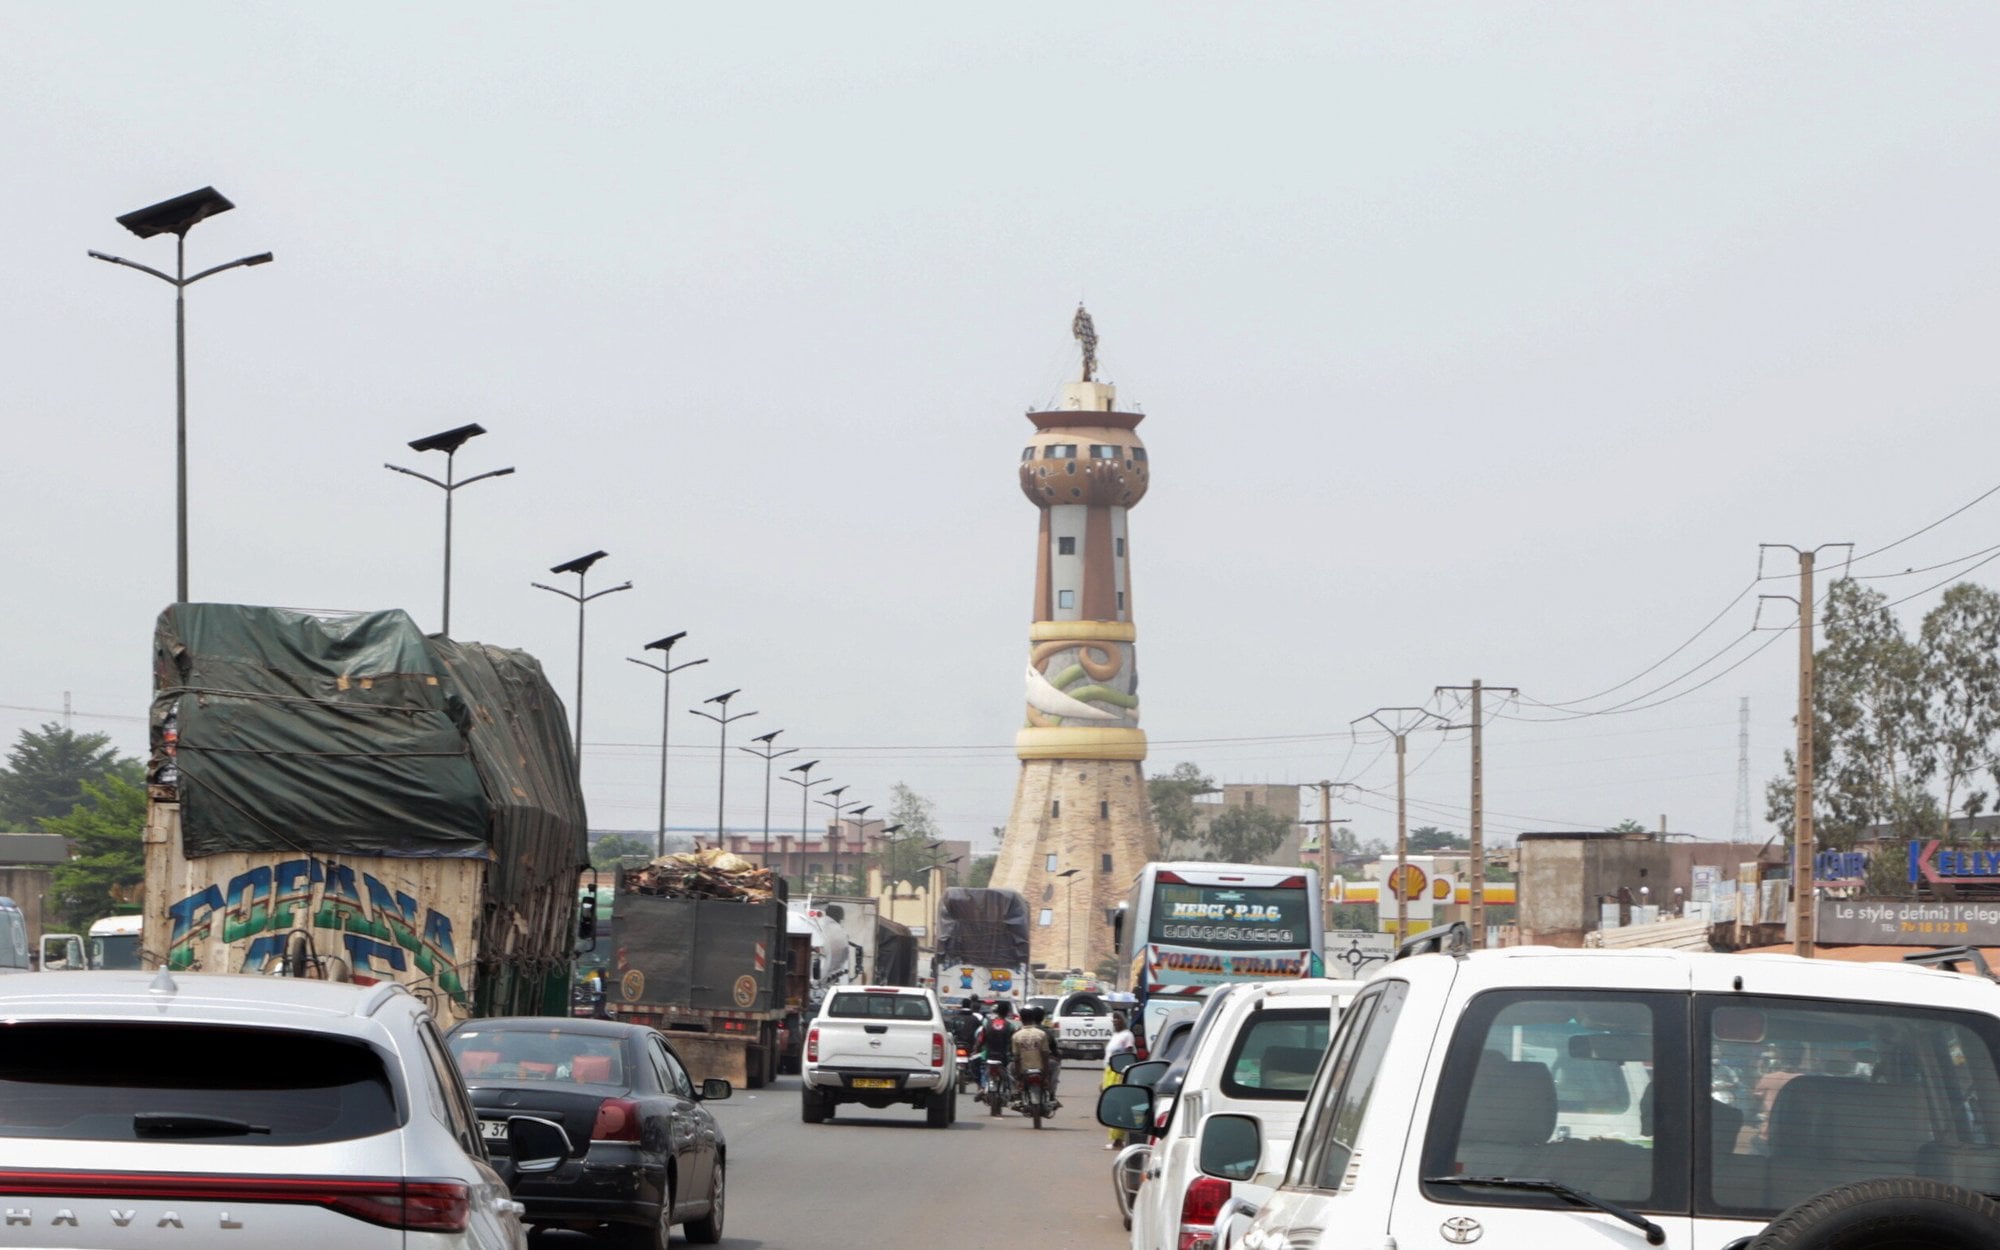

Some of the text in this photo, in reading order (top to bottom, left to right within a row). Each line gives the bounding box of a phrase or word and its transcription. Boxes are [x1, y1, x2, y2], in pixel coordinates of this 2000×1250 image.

[1173, 902, 1226, 921] MERCI
[1836, 904, 1854, 919] Le
[1858, 904, 1894, 924] style
[1954, 904, 2000, 925] l'eleg
[168, 857, 471, 1009] FOFANA
[1066, 1028, 1112, 1037] TOYOTA
[6, 1208, 243, 1229] HAVAL
